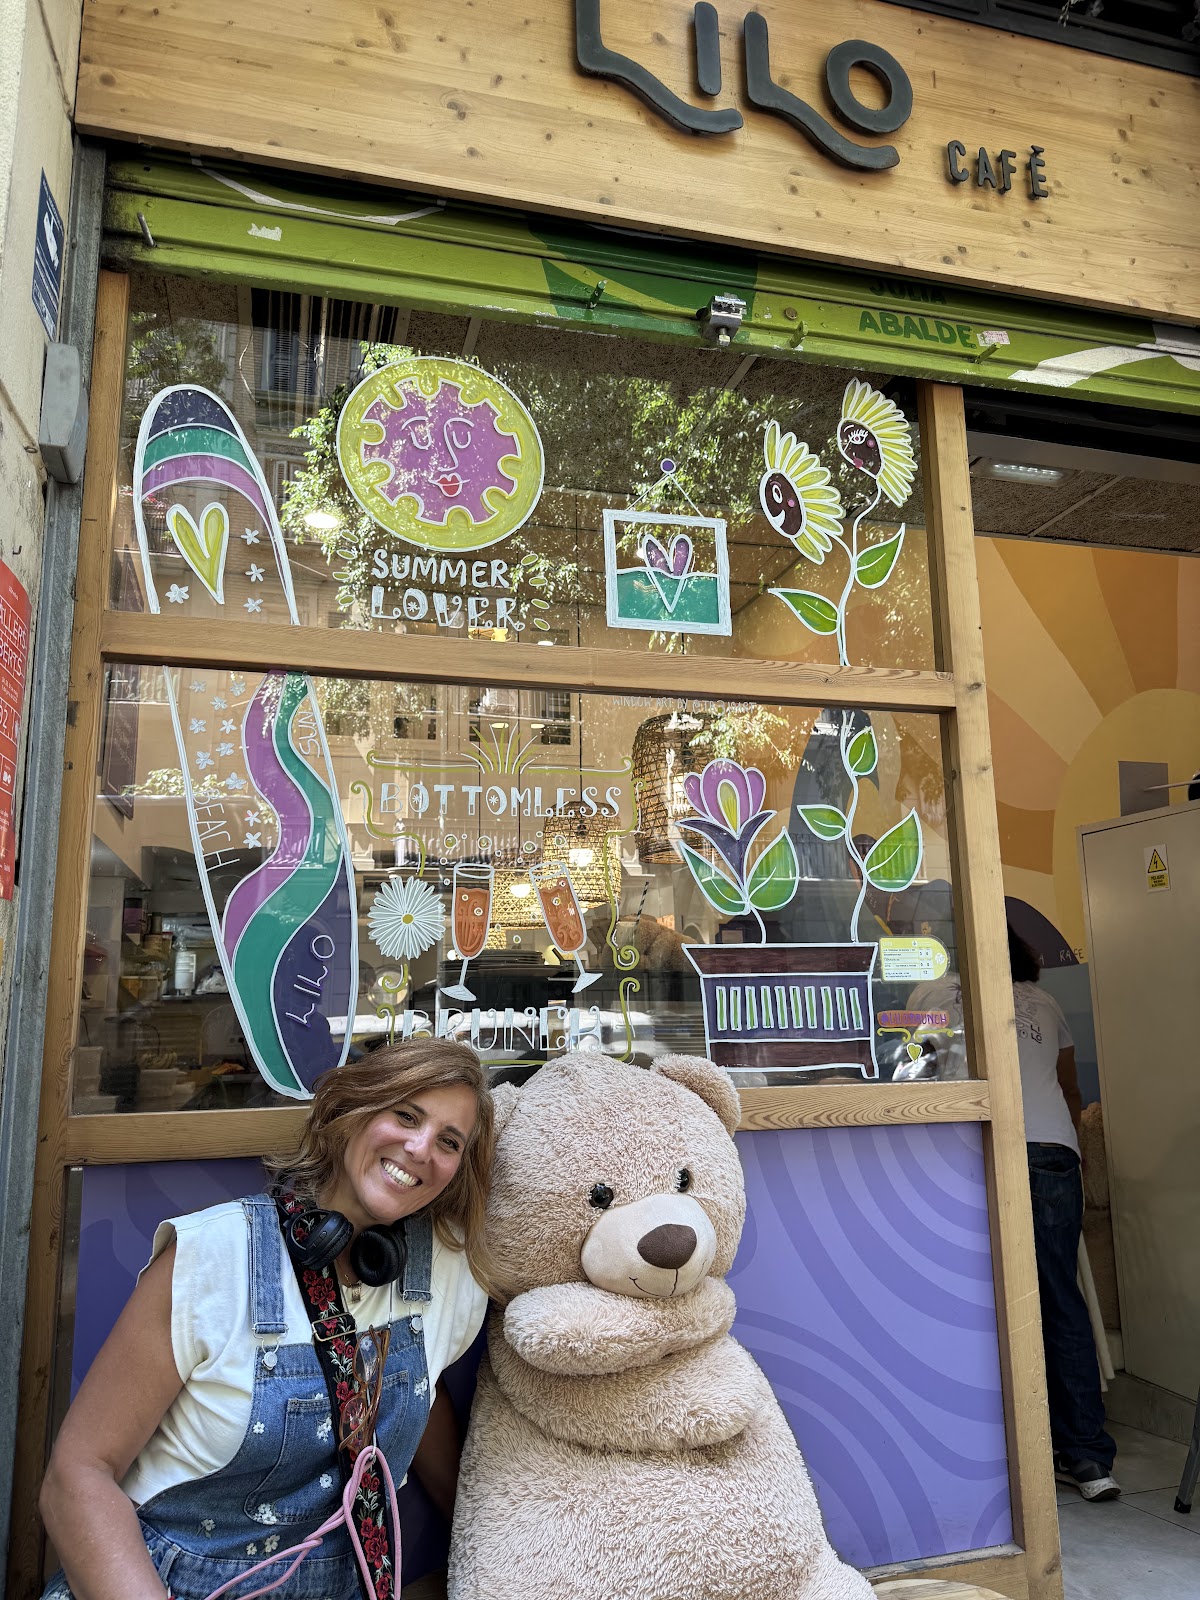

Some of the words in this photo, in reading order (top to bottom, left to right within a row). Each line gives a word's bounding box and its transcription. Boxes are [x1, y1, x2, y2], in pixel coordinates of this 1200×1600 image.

[575, 0, 914, 171] LILO
[372, 548, 510, 588] SUMMER
[371, 585, 526, 631] LOVER
[612, 696, 652, 707] WINDOW
[656, 697, 674, 709] ART
[677, 697, 689, 711] BY
[298, 710, 321, 758] SUN
[380, 781, 622, 818] BOTTOMLESS
[192, 787, 241, 873] BEACH
[285, 934, 336, 1028] LILO
[402, 1005, 603, 1052] BRUNCH
